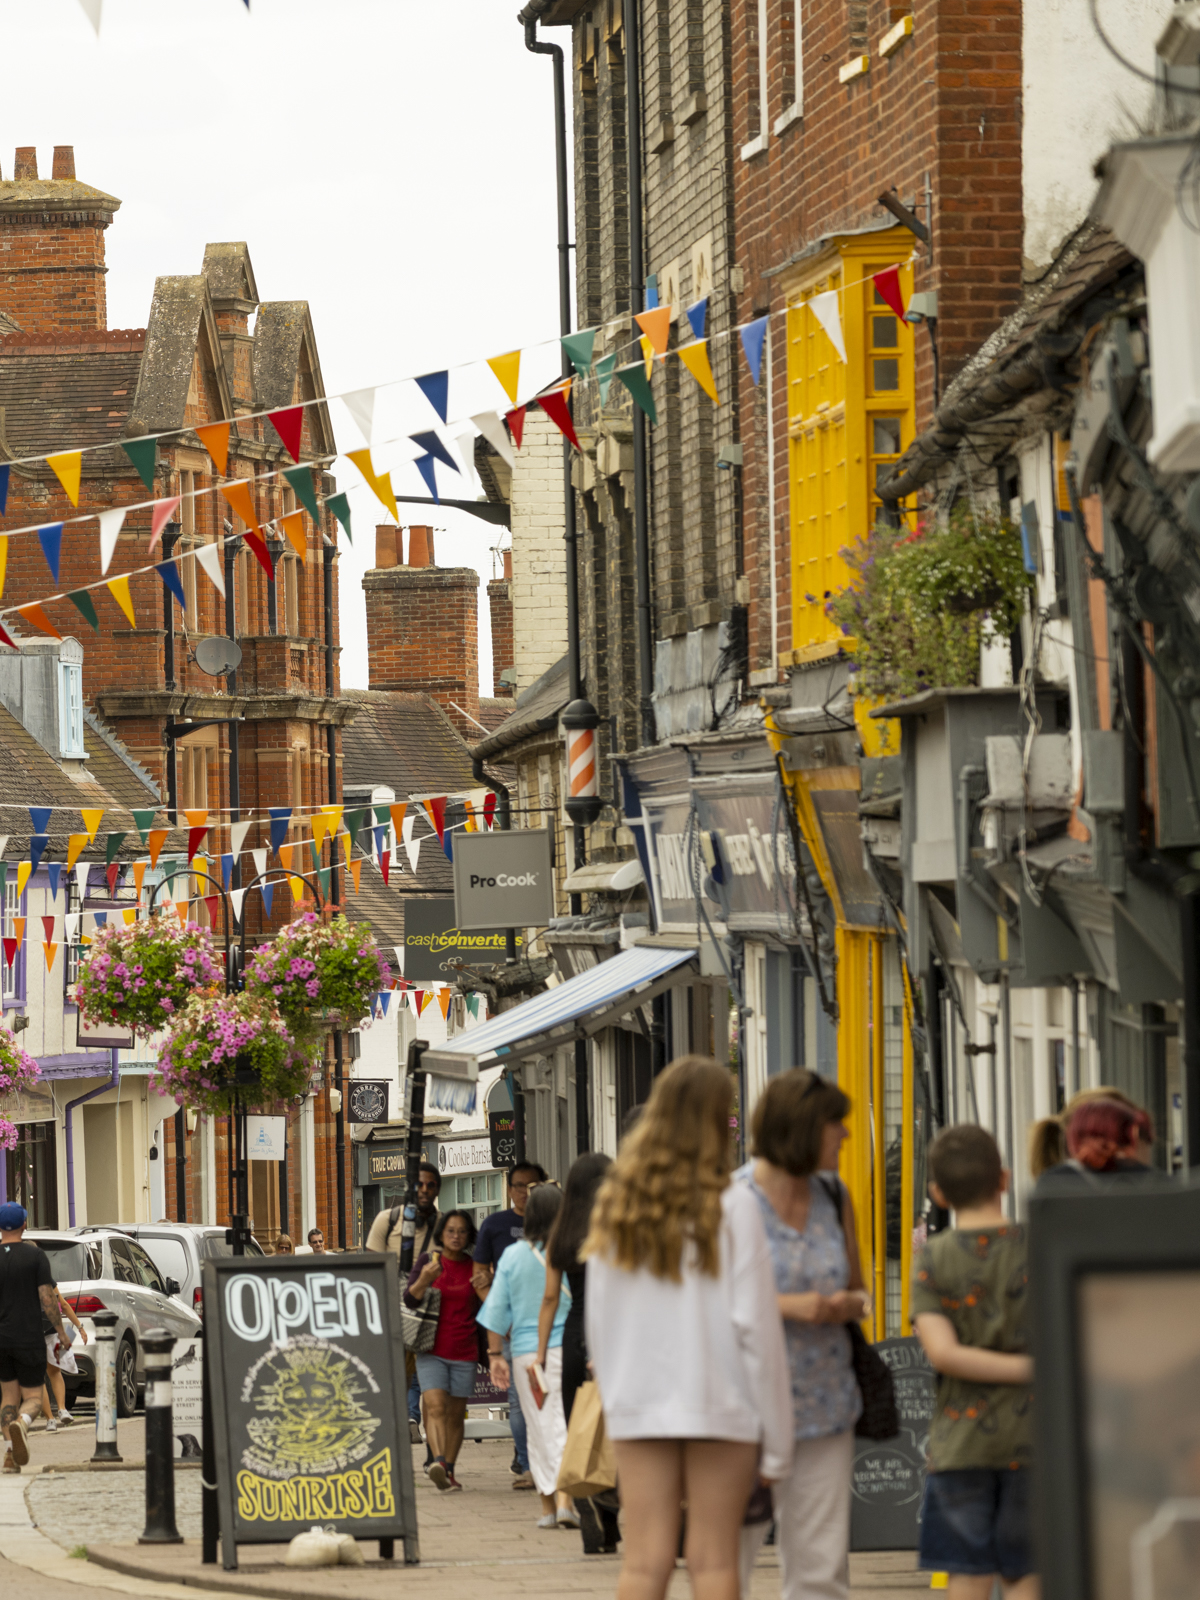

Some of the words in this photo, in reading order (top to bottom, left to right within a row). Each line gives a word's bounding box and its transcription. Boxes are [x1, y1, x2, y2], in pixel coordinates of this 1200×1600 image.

[406, 932, 523, 946] cashconvertes
[353, 1084, 382, 1098] ANDREW'S
[372, 1157, 386, 1173] TRUE
[386, 1154, 406, 1172] CROWN
[448, 1146, 470, 1168] Cookie
[911, 1346, 933, 1368] YO
[236, 1446, 396, 1522] SUNRISE
